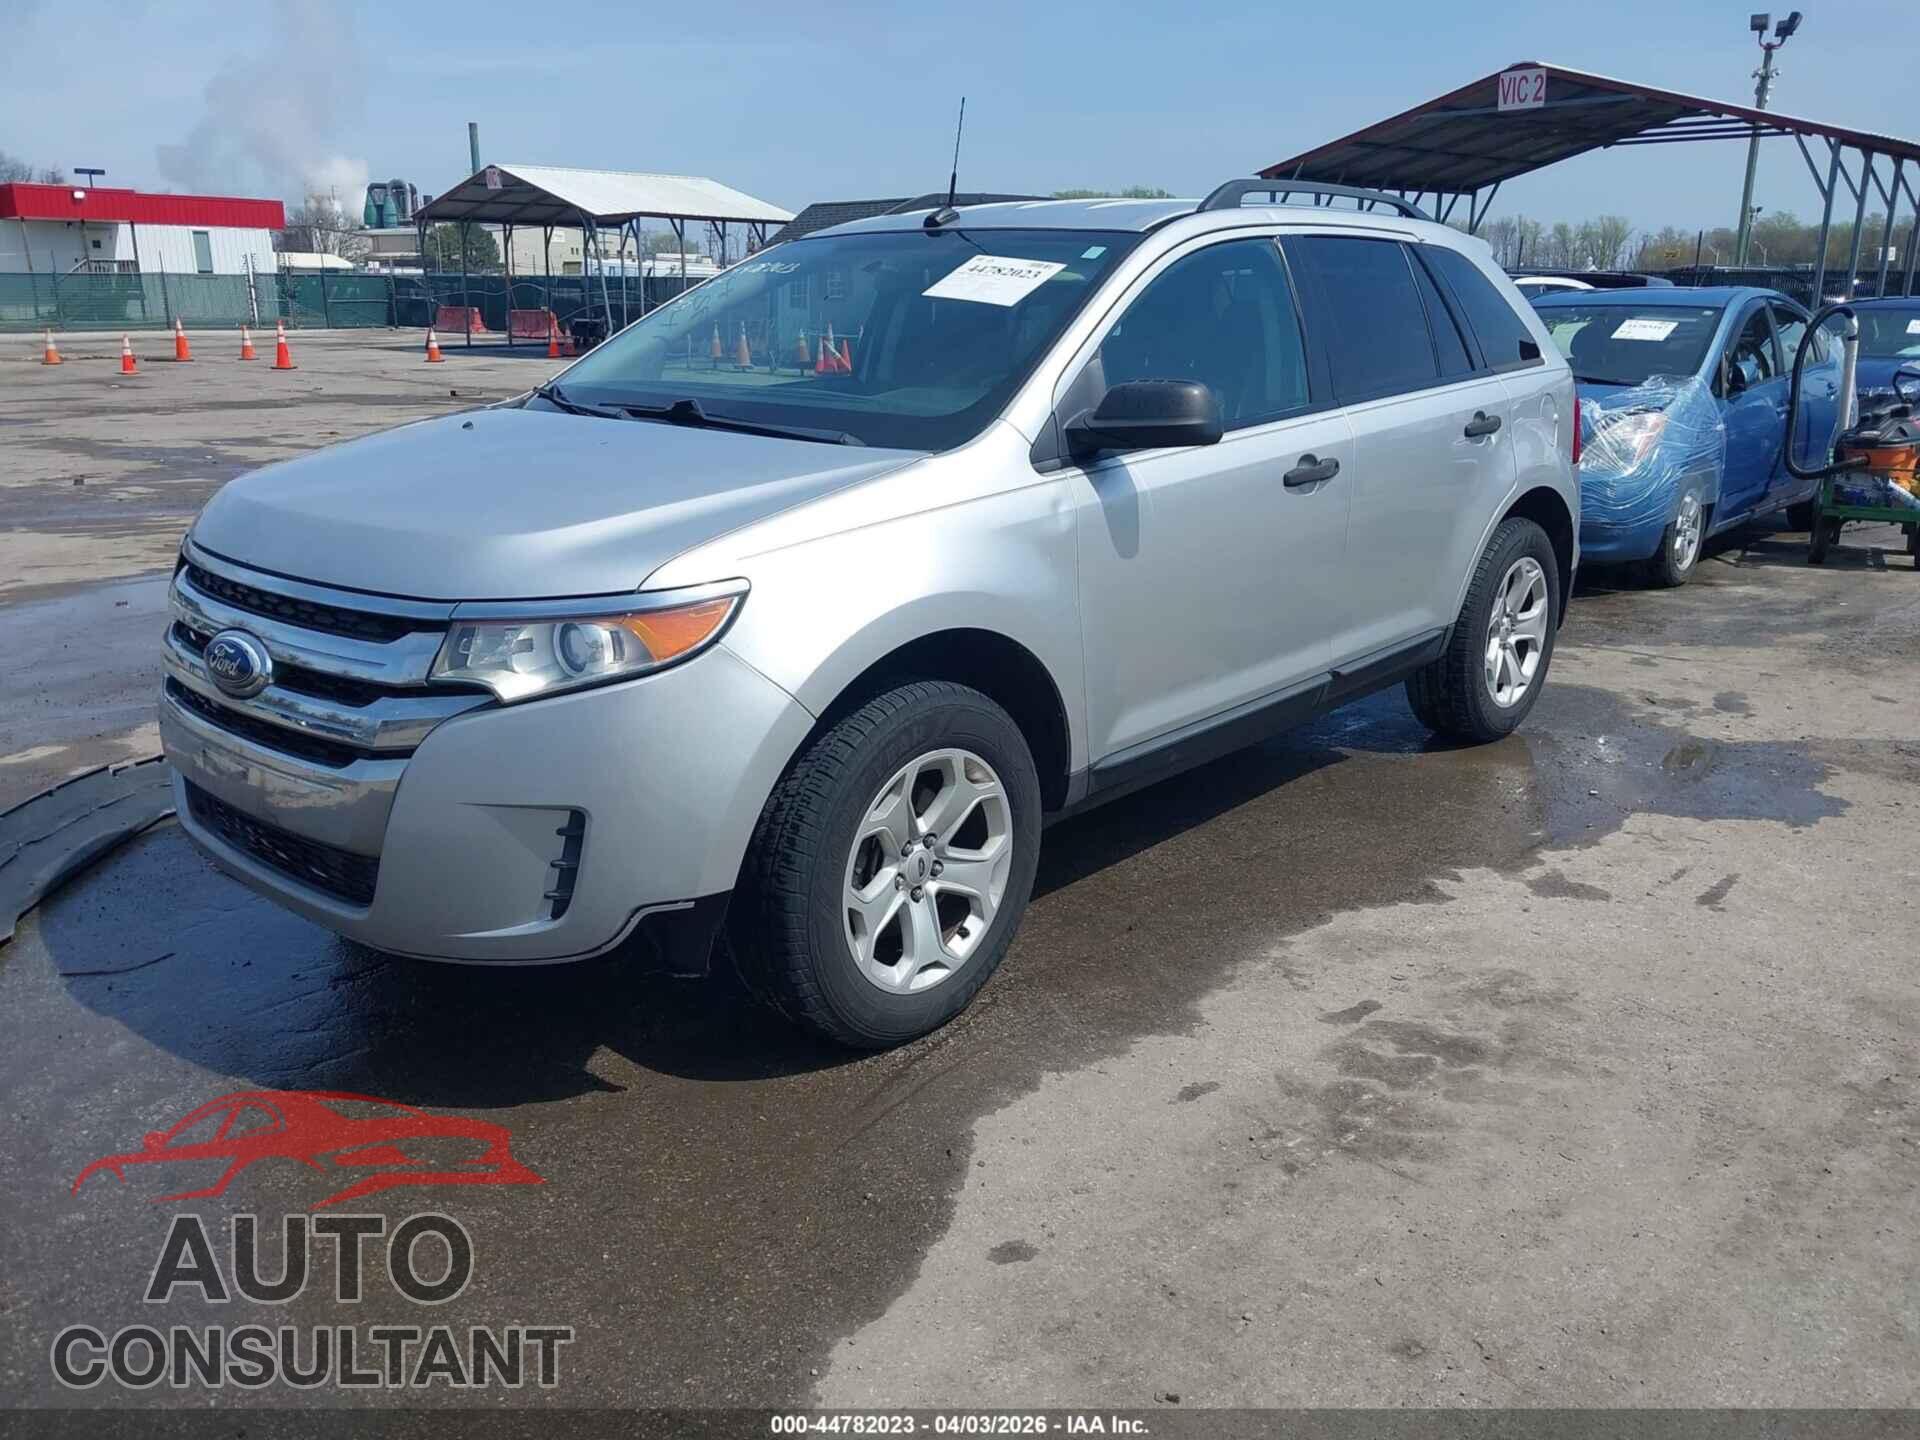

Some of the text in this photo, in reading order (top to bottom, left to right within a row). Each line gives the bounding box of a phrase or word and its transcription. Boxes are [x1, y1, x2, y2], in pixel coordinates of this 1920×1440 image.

[1500, 74, 1544, 105] VIC 2
[967, 263, 1042, 280] 44782023
[209, 643, 241, 676] Ford
